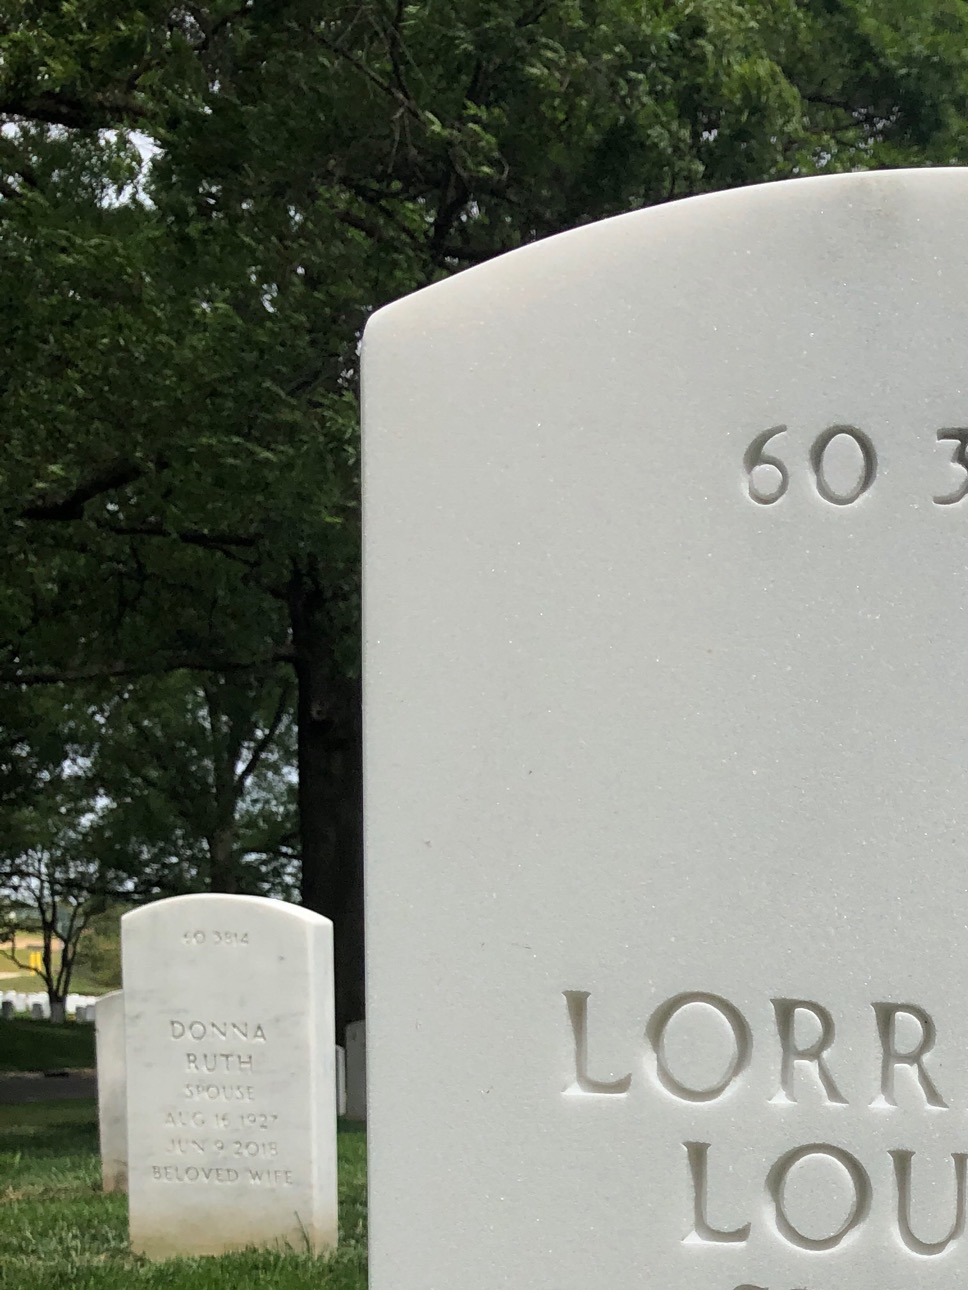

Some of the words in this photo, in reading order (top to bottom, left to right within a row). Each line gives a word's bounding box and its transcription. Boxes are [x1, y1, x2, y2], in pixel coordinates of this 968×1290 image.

[743, 424, 878, 505] 60
[169, 1020, 267, 1042] DONNA
[186, 1052, 253, 1073] RUTH
[185, 1083, 256, 1101] SPOUSE
[164, 1111, 206, 1128] AUG
[166, 1137, 206, 1154] JUN
[151, 1164, 240, 1184] BELOVED
[248, 1168, 294, 1186] WIFE
